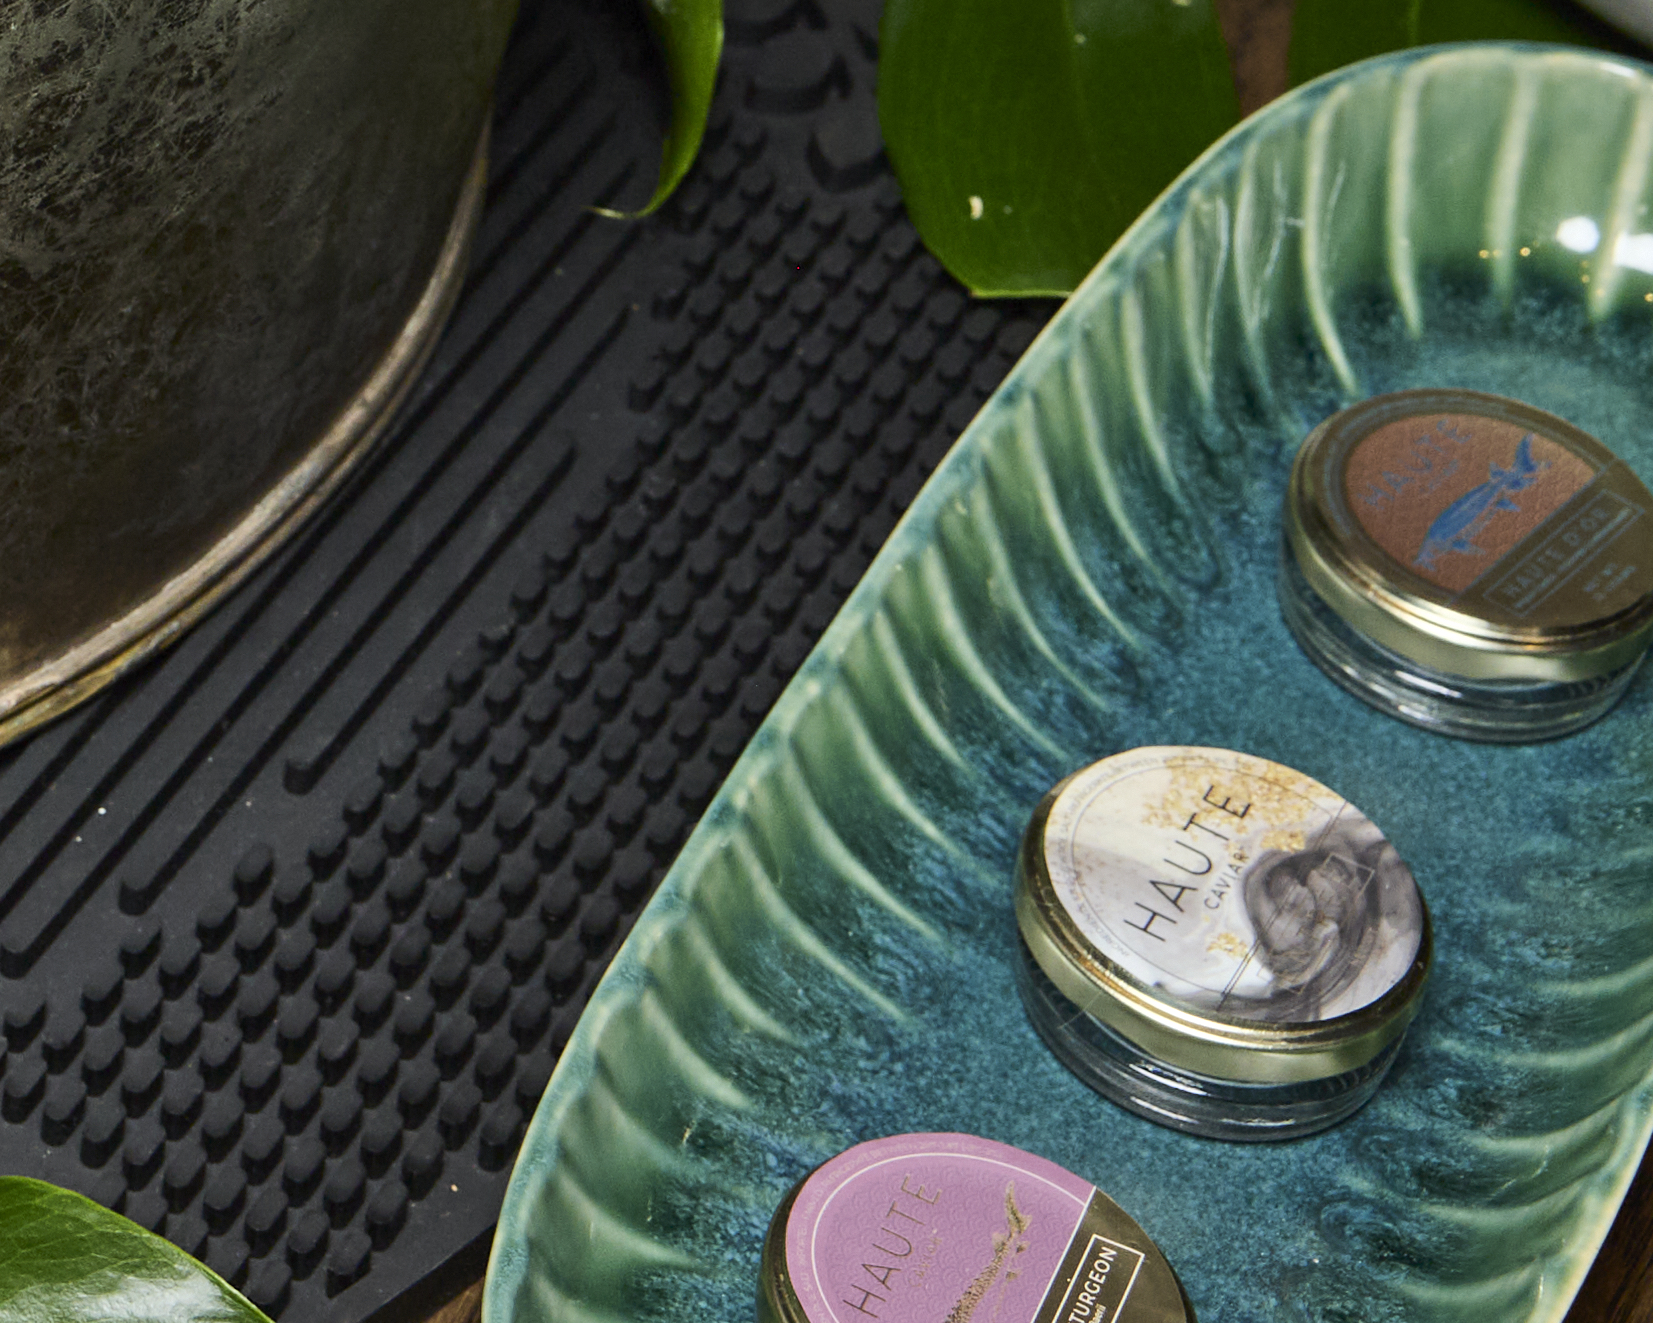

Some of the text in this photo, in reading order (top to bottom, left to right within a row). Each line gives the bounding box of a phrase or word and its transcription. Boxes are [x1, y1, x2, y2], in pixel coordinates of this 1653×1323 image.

[1122, 784, 1252, 943] HAUTE
[842, 1173, 943, 1319] HAUTE
[1067, 1246, 1118, 1323] TURGEON
